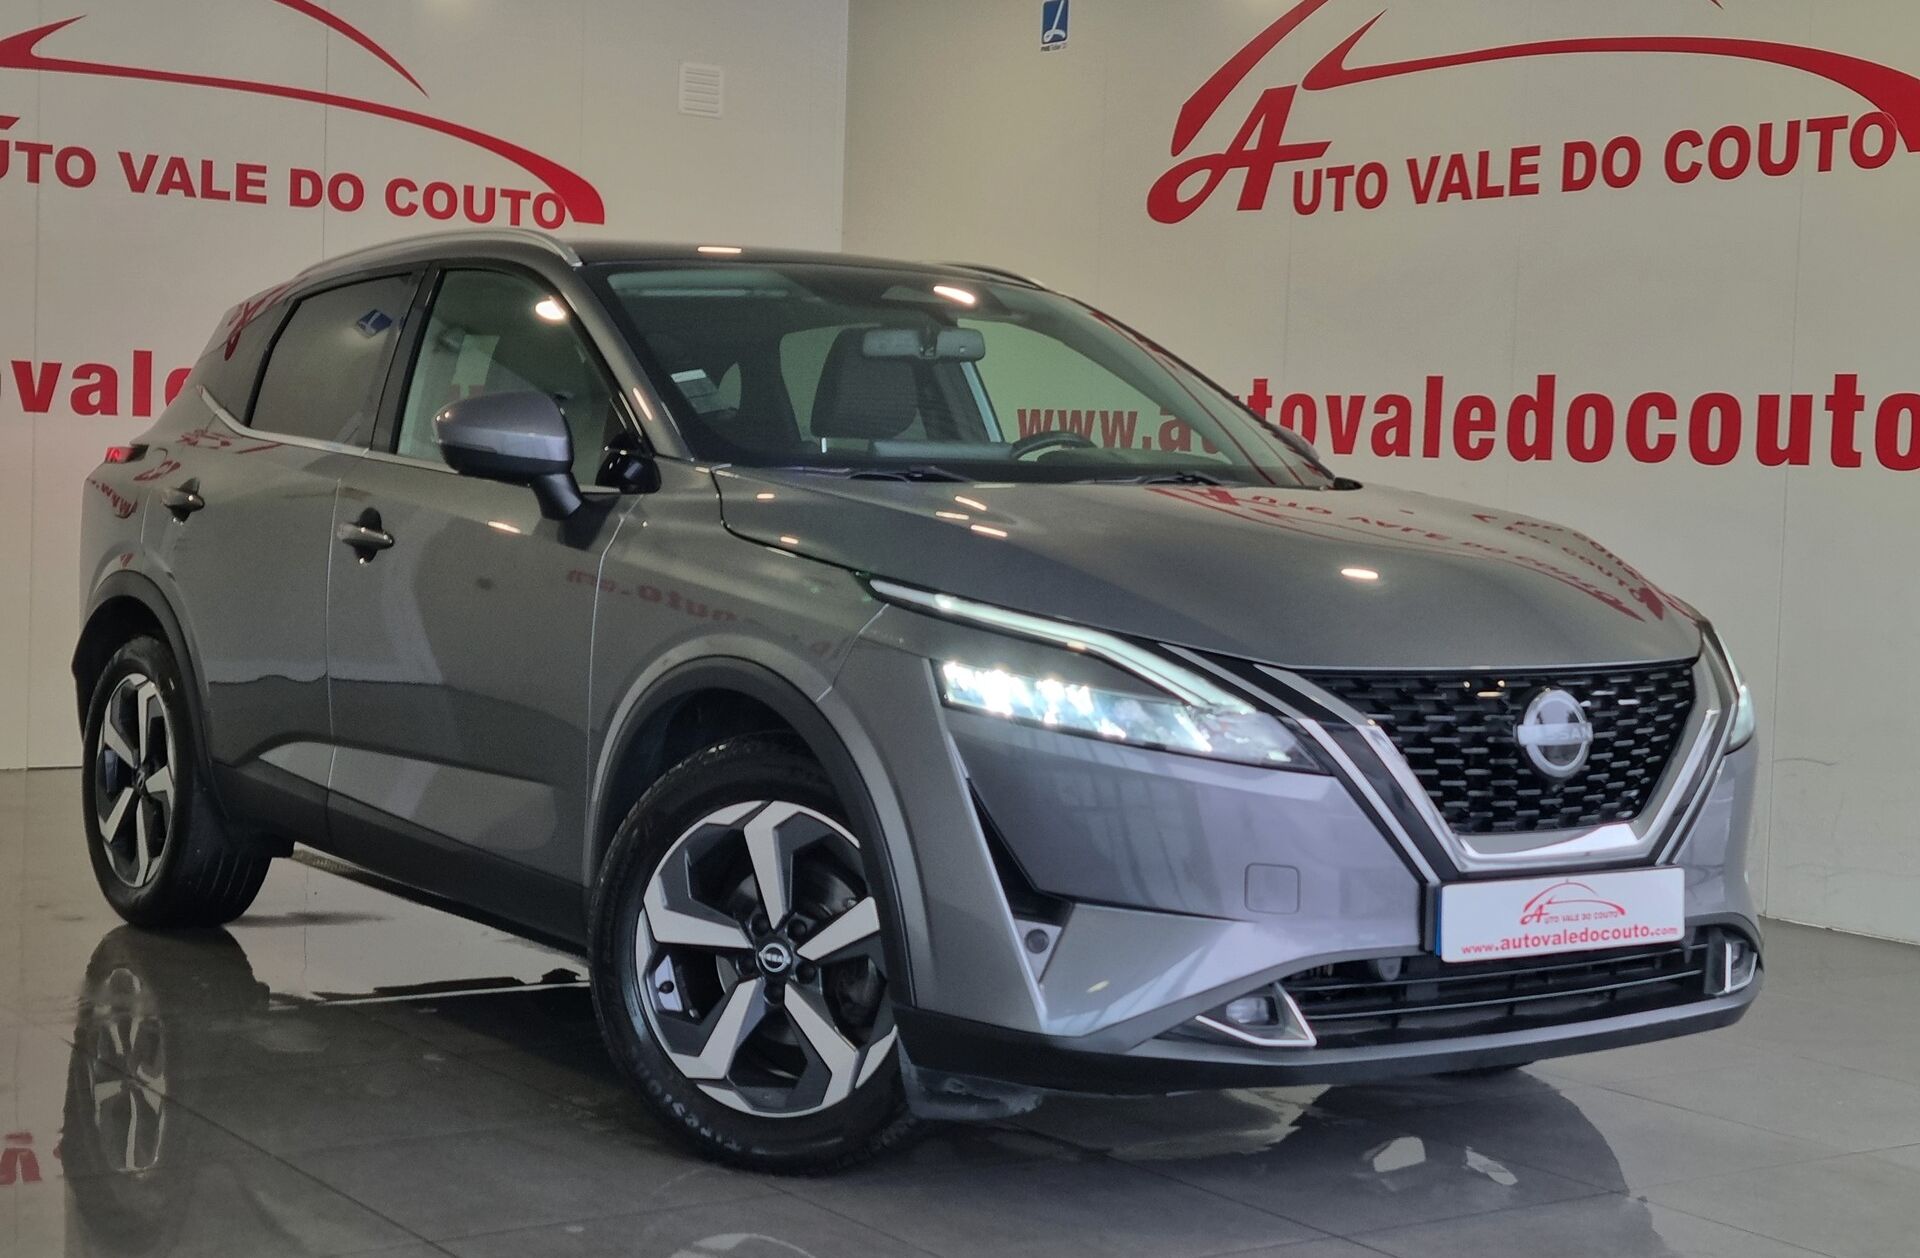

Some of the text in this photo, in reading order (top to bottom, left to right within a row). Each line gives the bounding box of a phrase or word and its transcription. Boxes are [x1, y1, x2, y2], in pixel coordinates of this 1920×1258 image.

[0, 139, 567, 230] TO VALE DO COUTO
[1146, 83, 1898, 225] AUTO VALE DO COUTO
[1460, 923, 1679, 955] www.autovaledocouto.com
